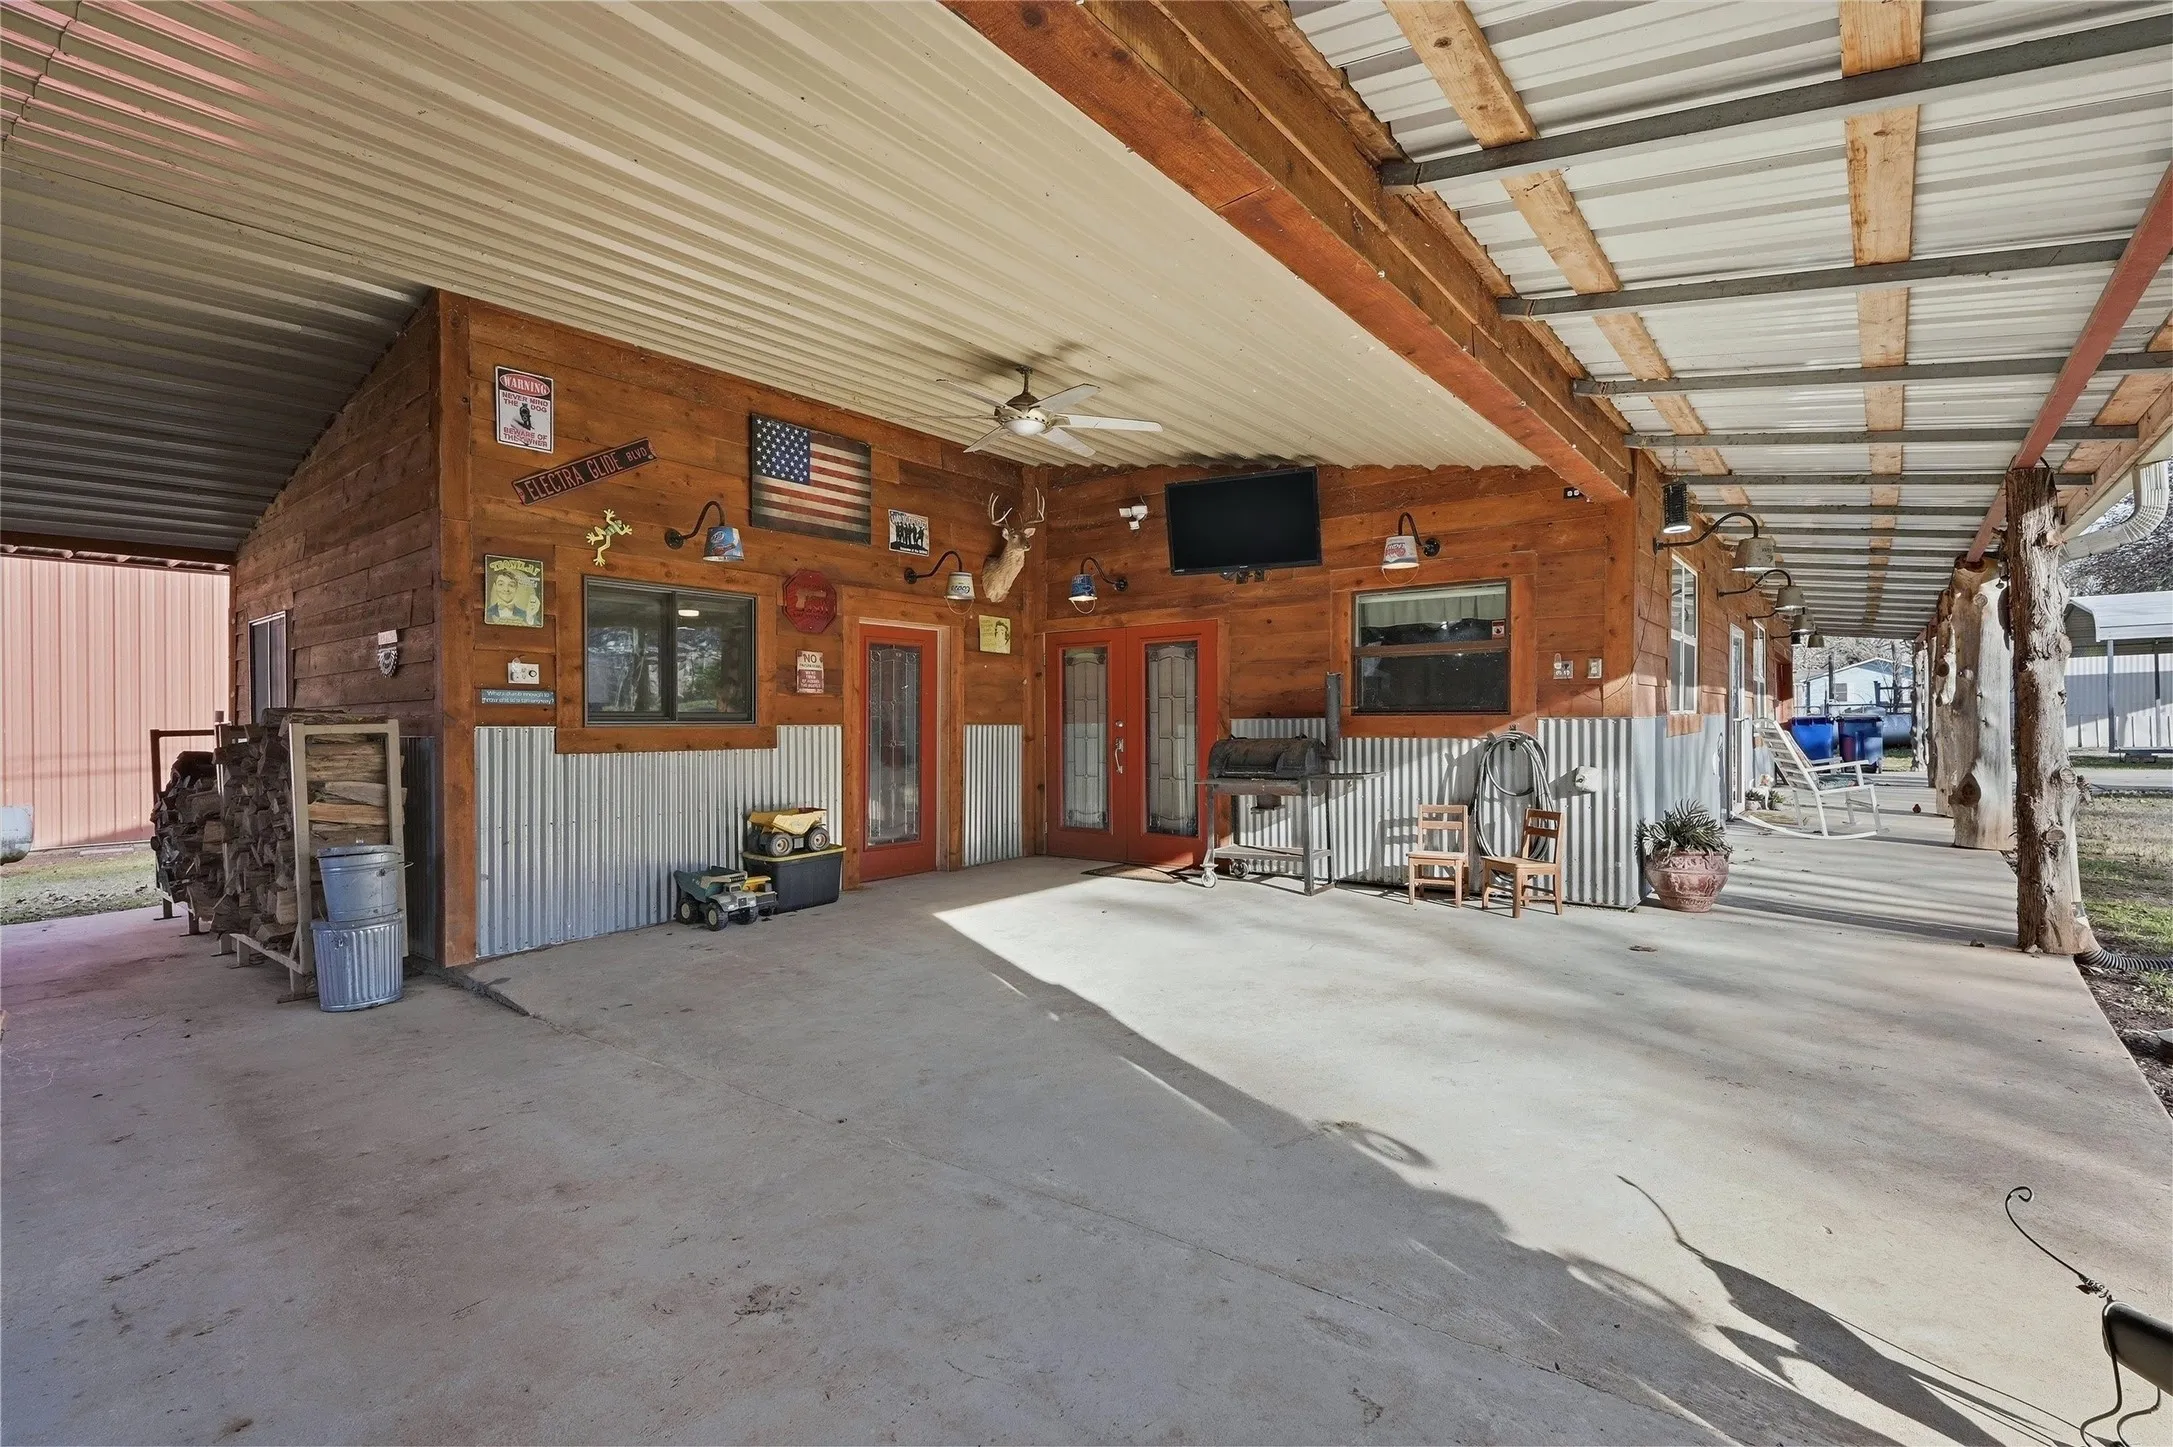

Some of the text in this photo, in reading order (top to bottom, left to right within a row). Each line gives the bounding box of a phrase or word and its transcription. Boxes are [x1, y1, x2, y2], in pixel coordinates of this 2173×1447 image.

[503, 375, 547, 394] WARNING
[502, 392, 549, 407] NEVER MIND
[503, 399, 548, 413] THE DOG
[503, 426, 535, 438] BEWARE
[503, 433, 518, 441] THE
[524, 447, 648, 501] ELECTRA GLIDE BLVD
[803, 654, 817, 663] NO
